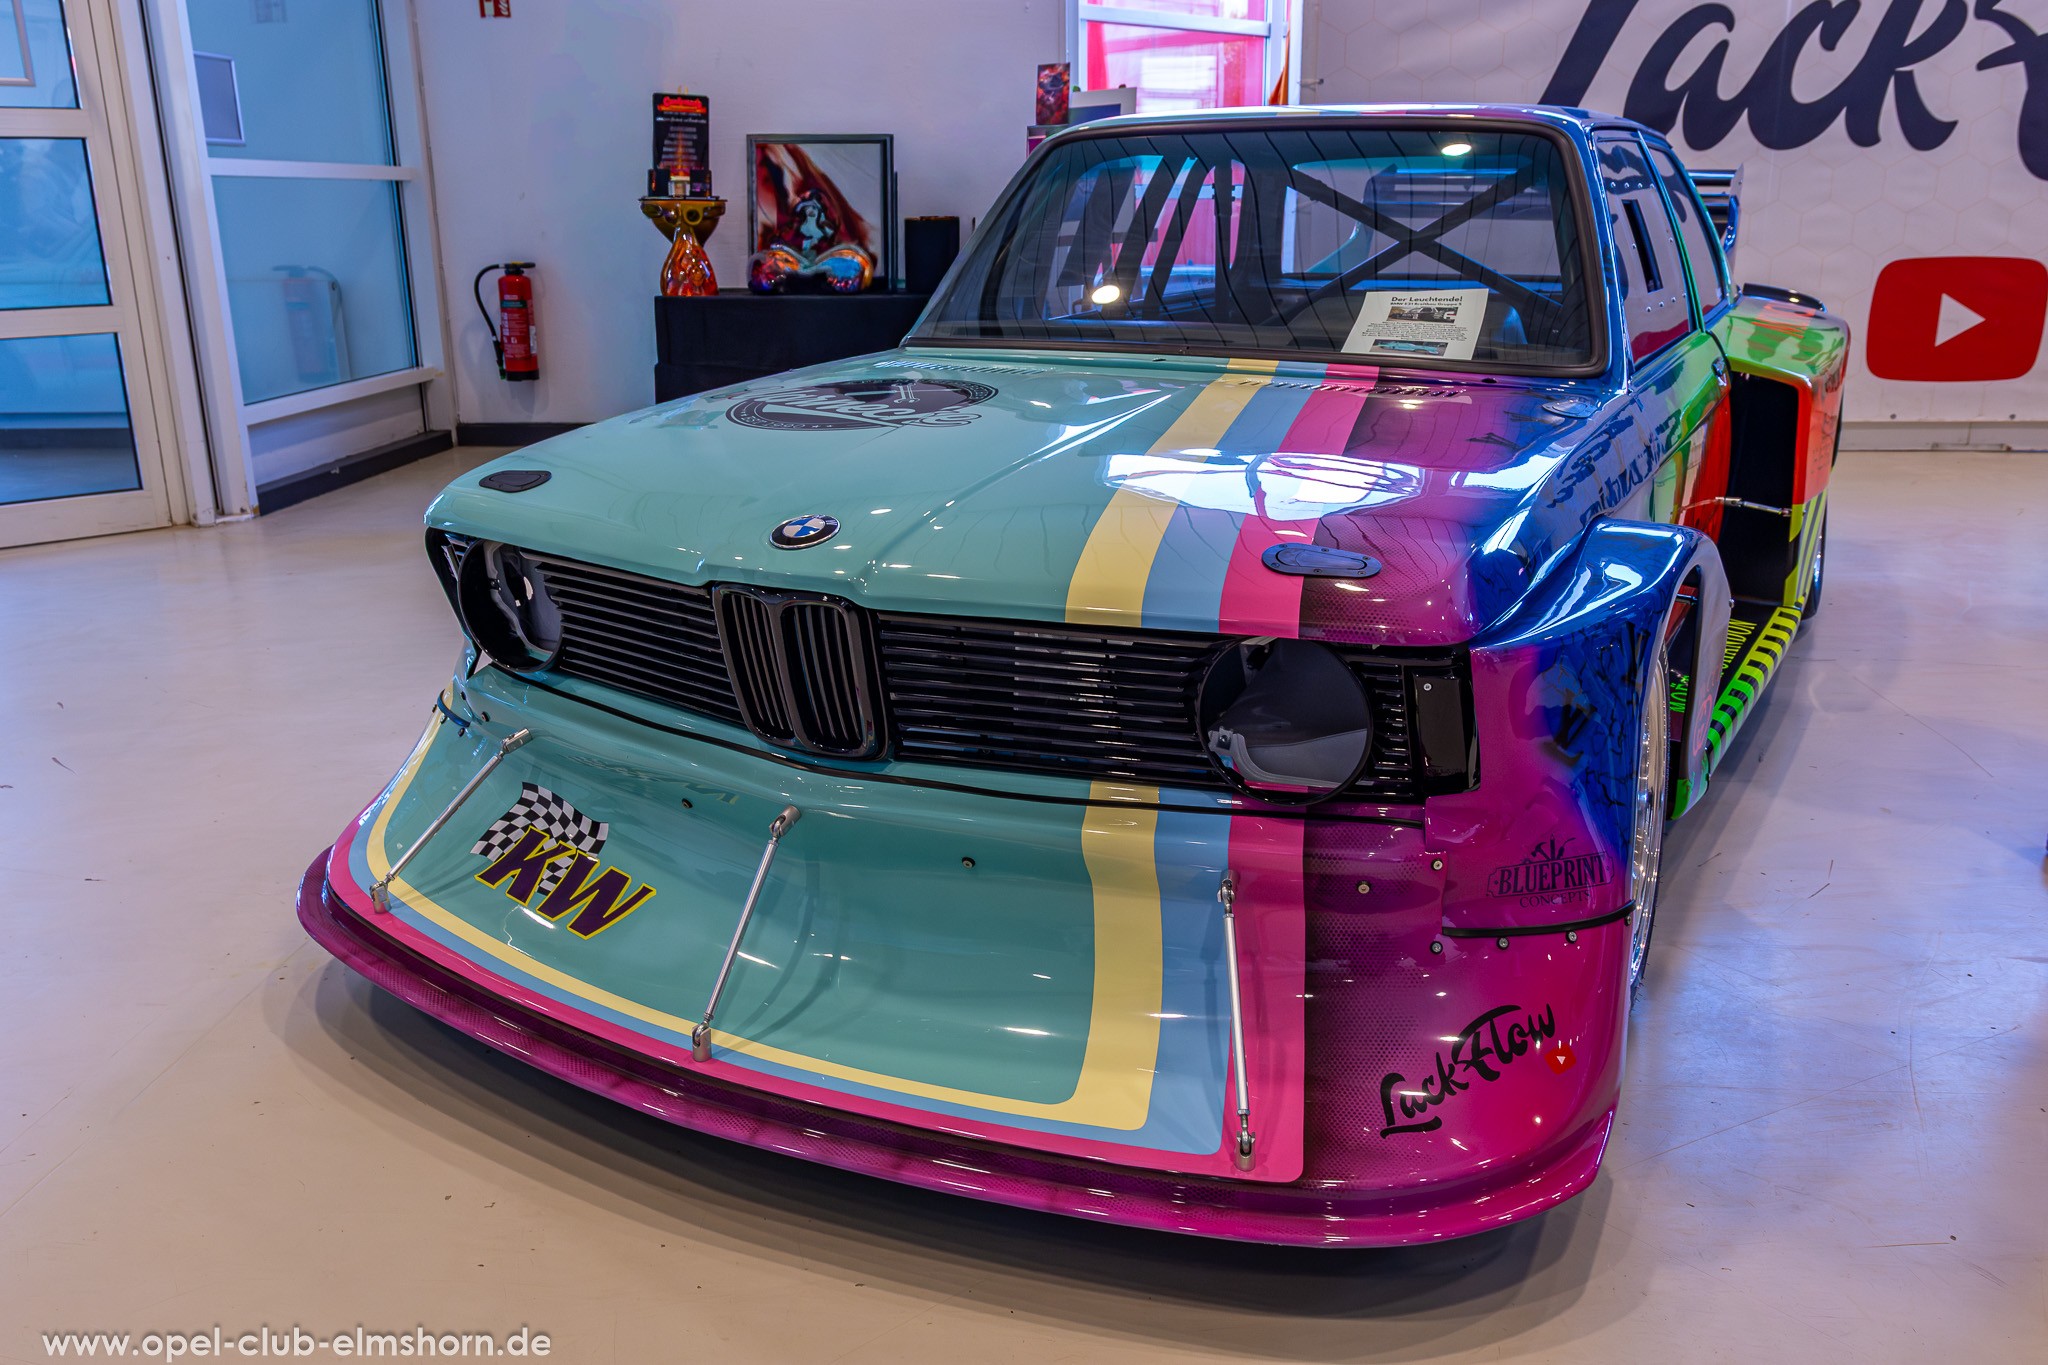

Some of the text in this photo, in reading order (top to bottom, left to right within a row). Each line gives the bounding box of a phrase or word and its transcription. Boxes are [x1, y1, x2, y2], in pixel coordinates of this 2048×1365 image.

[474, 825, 657, 940] KW
[1498, 855, 1605, 895] BLUEPRINT
[1520, 889, 1592, 908] CONCEPTS
